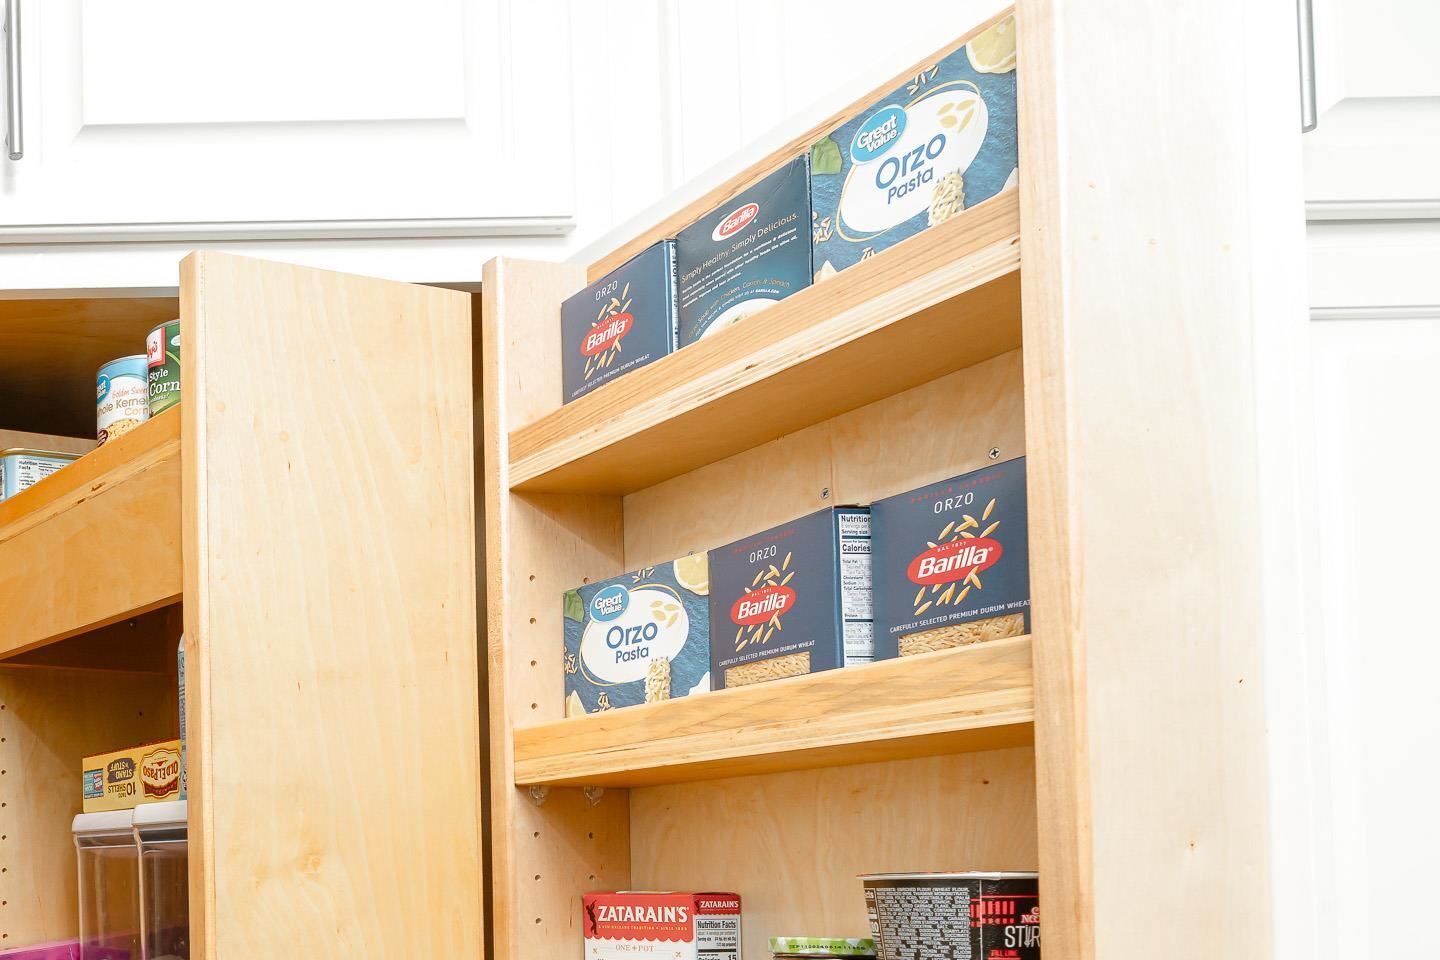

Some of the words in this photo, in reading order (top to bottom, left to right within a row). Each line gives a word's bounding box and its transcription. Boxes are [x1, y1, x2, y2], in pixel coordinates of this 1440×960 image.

[856, 113, 898, 149] Great
[866, 127, 900, 153] Value
[875, 132, 947, 190] Orzo
[886, 165, 934, 206] Pasta
[722, 205, 757, 234] Barilla
[681, 266, 702, 284] Simply
[731, 234, 756, 253] Simply
[595, 279, 618, 302] ORZO
[586, 319, 627, 352] Barilla
[149, 381, 180, 396] Corn
[933, 491, 975, 515] ORZO
[749, 544, 778, 564] ORZO
[842, 544, 871, 552] Calories
[917, 545, 990, 579] Barilla
[594, 592, 623, 609] Great
[737, 595, 787, 620] Barilla
[889, 621, 919, 634] CAREFULLY
[919, 615, 948, 627] SELECTED
[948, 608, 979, 621] PREMIUM
[980, 603, 1005, 615] DURUM
[606, 621, 658, 650] Orzo
[615, 646, 649, 664] Pasta
[758, 647, 779, 659] PREMIUM
[779, 643, 797, 655] DURUM
[798, 640, 815, 649] WHEAT
[126, 782, 137, 796] 10
[598, 906, 688, 923] ZATARAIN'S
[700, 900, 739, 909] ZATARAIN'S
[697, 920, 721, 929] Nutrition
[722, 920, 736, 930] Facts
[615, 944, 631, 952] ONE
[638, 945, 655, 953] POT
